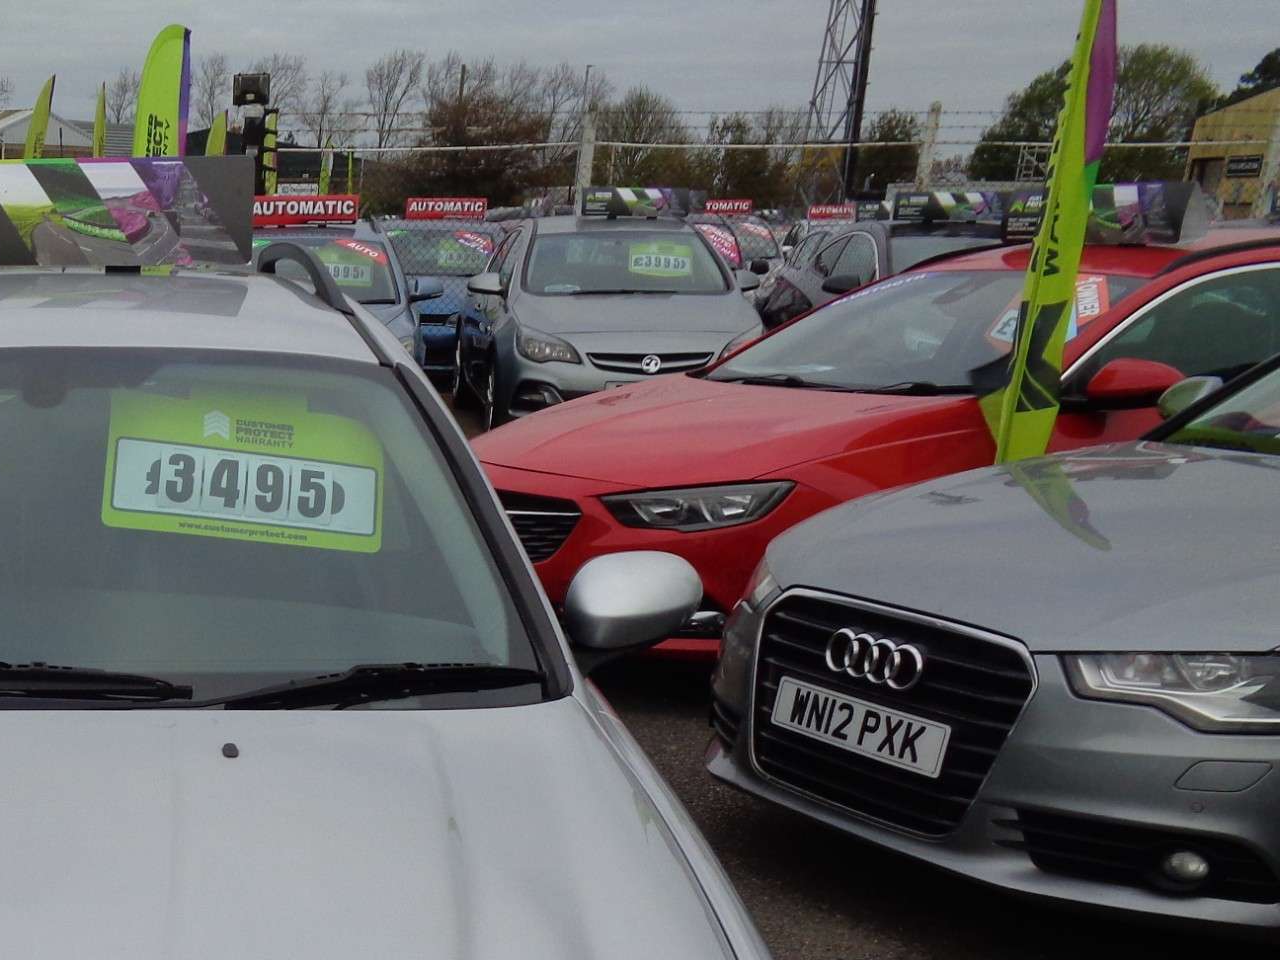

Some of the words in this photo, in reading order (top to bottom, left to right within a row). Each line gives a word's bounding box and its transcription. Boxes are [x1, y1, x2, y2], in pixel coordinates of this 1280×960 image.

[253, 200, 355, 216] AUTOMATIC
[408, 201, 484, 213] AUTOMATIC
[347, 242, 379, 258] AUTO
[235, 418, 294, 432] CUSTOMER
[235, 426, 295, 440] PROTECT
[856, 708, 926, 764] PXK
